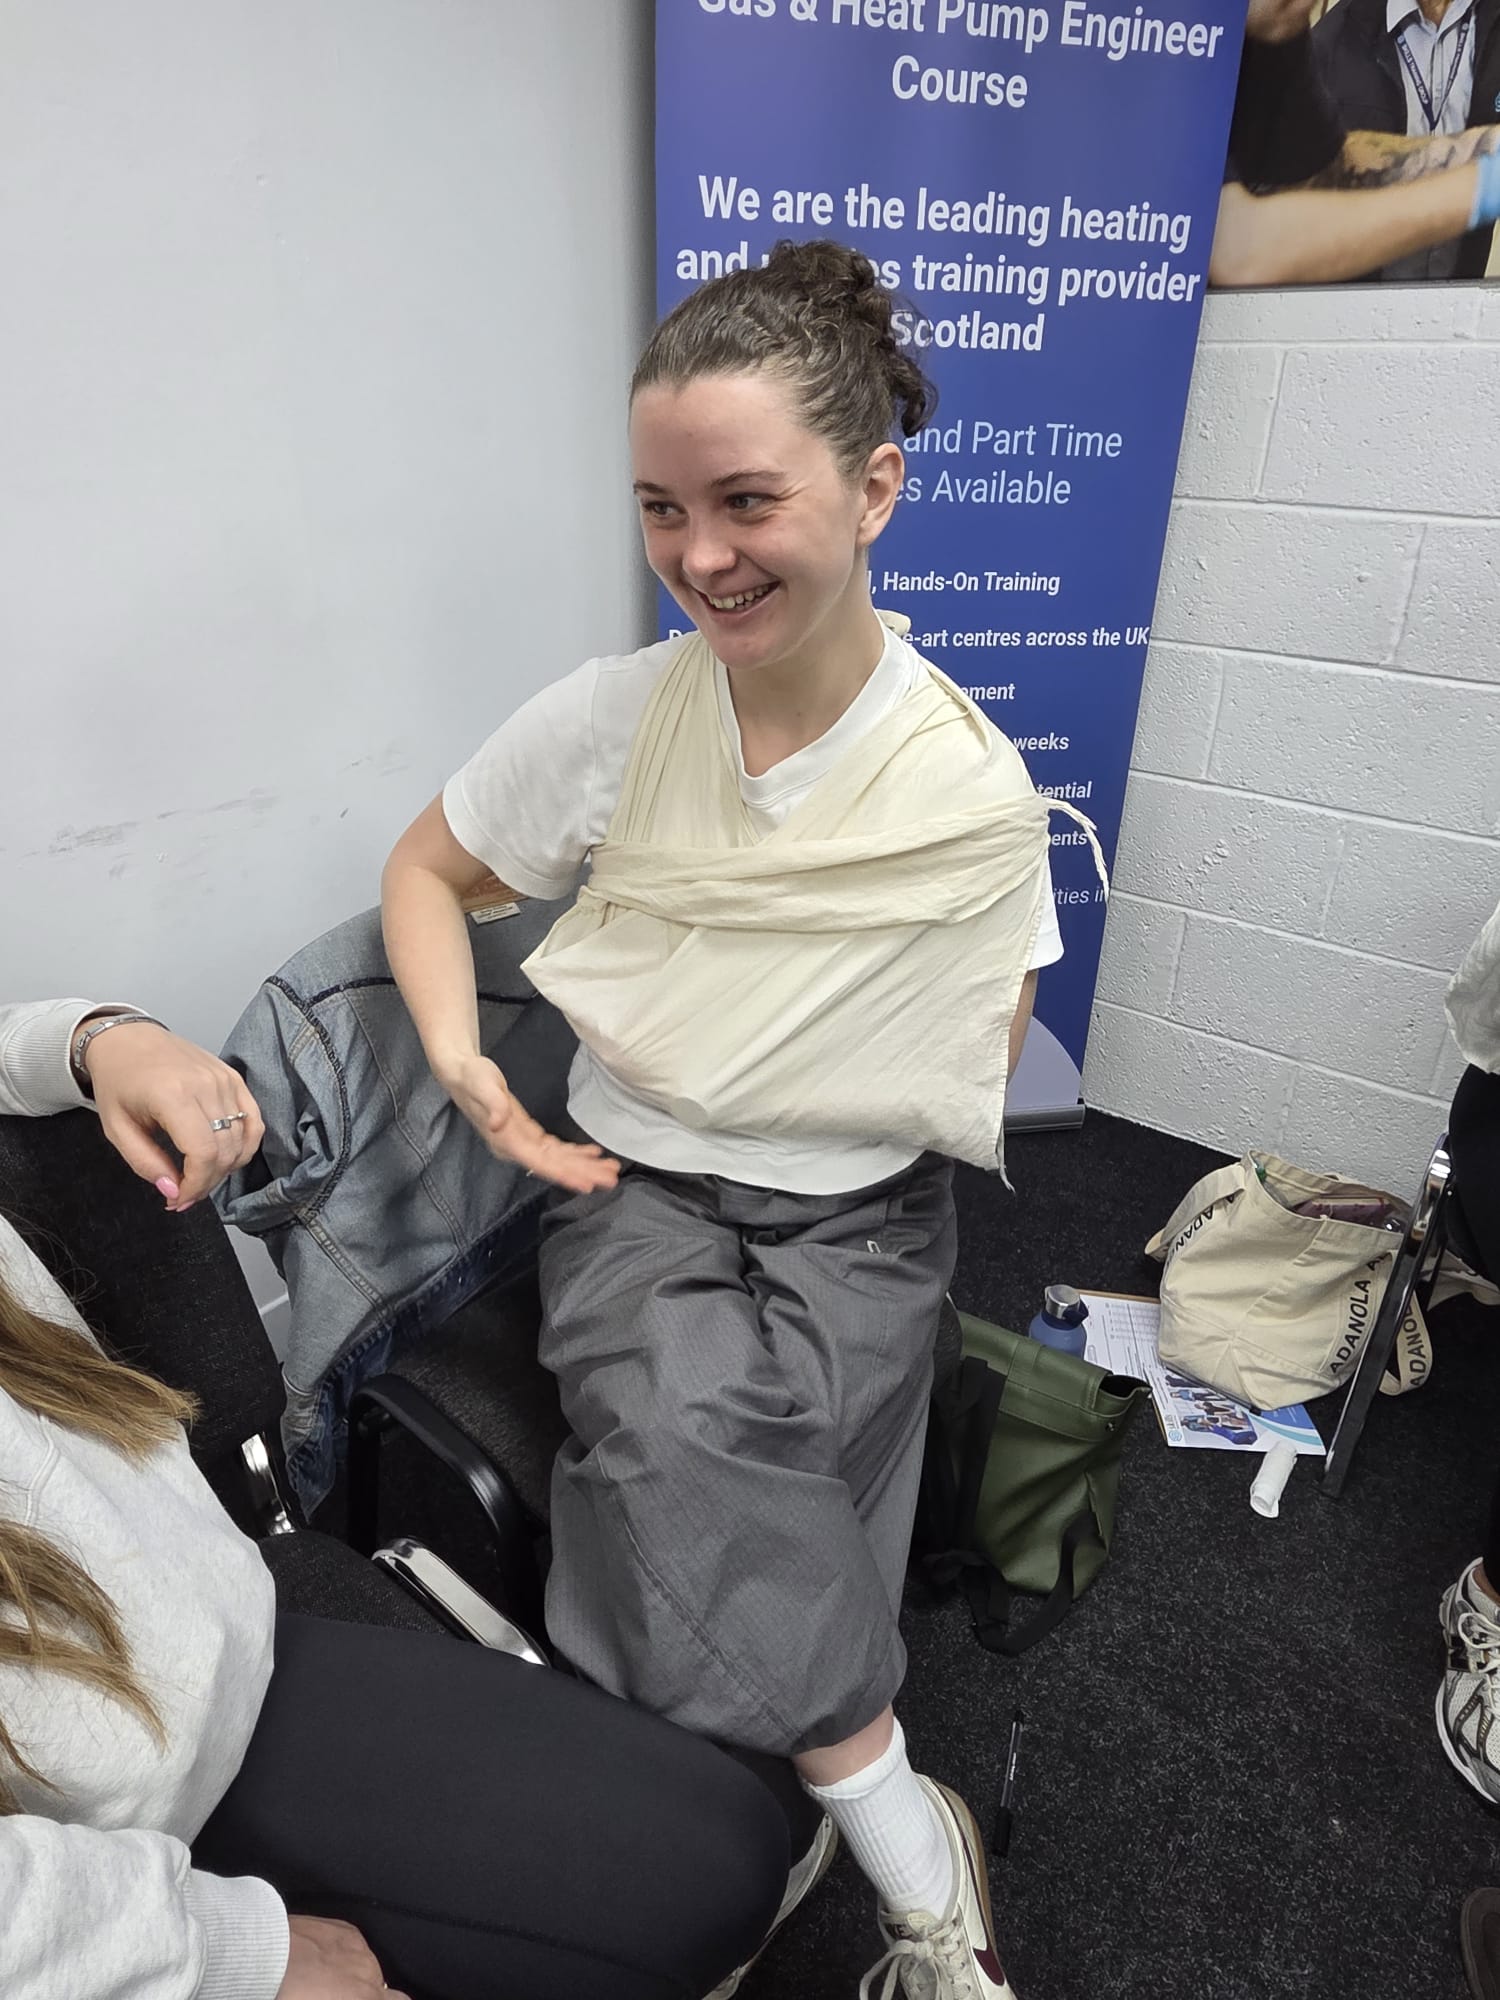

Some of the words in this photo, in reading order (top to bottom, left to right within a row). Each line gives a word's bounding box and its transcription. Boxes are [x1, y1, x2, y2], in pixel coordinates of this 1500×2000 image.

[832, 0, 925, 33] Heat
[937, 0, 1049, 53] Pump
[1060, 1, 1224, 62] Engineer
[892, 54, 1029, 108] Course
[698, 175, 760, 220] We
[772, 190, 834, 226] are
[844, 183, 905, 229] the
[917, 187, 1050, 247] leading
[1060, 196, 1191, 254] heating
[676, 241, 748, 281] and
[912, 254, 1048, 303] training
[1058, 261, 1200, 306] provider
[890, 312, 1045, 352] Scotland
[903, 419, 963, 454] and
[972, 421, 1037, 456] Part
[1046, 423, 1123, 458] Time
[931, 470, 1072, 504] Available
[883, 571, 979, 592] Hands-On
[984, 571, 1061, 596] Training
[952, 630, 1020, 648] centres
[1025, 631, 1087, 648] across
[1092, 627, 1121, 646] the
[1125, 626, 1150, 646] UK
[1013, 732, 1070, 751] weeks
[1329, 1279, 1372, 1374] ADANOLA
